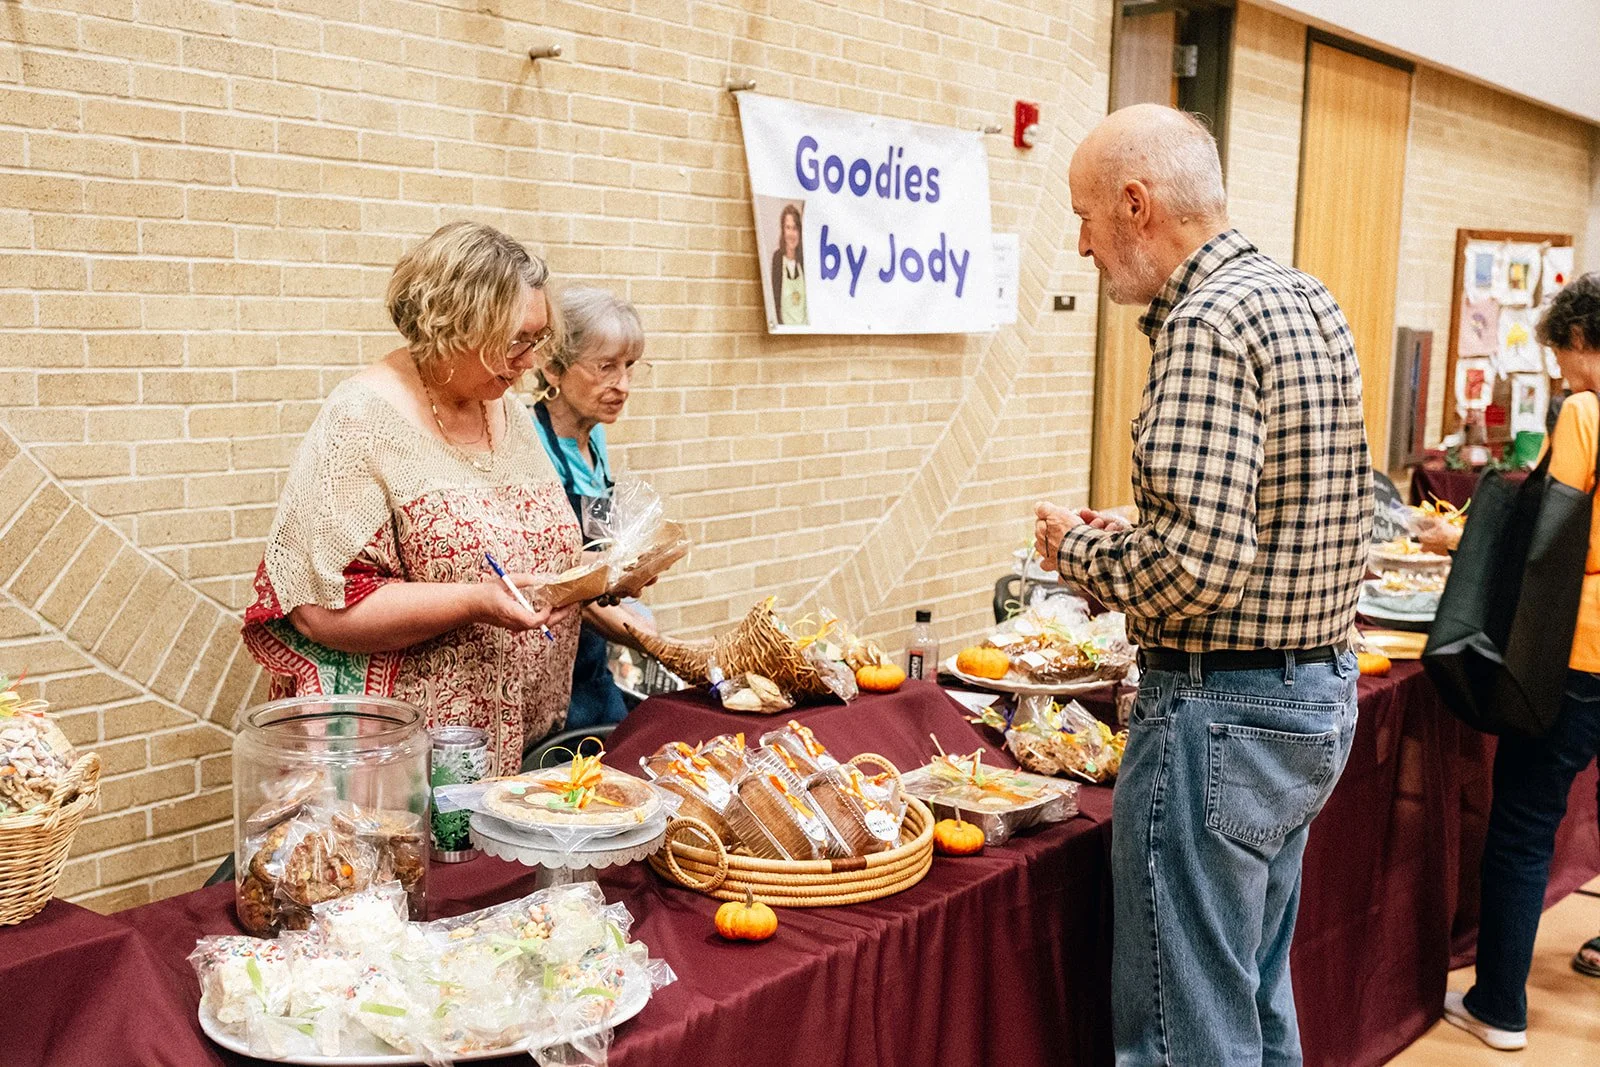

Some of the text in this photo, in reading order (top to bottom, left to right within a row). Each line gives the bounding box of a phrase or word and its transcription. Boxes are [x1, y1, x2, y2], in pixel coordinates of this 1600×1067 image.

[795, 135, 941, 203] Goodies
[819, 224, 970, 298] by Jody
